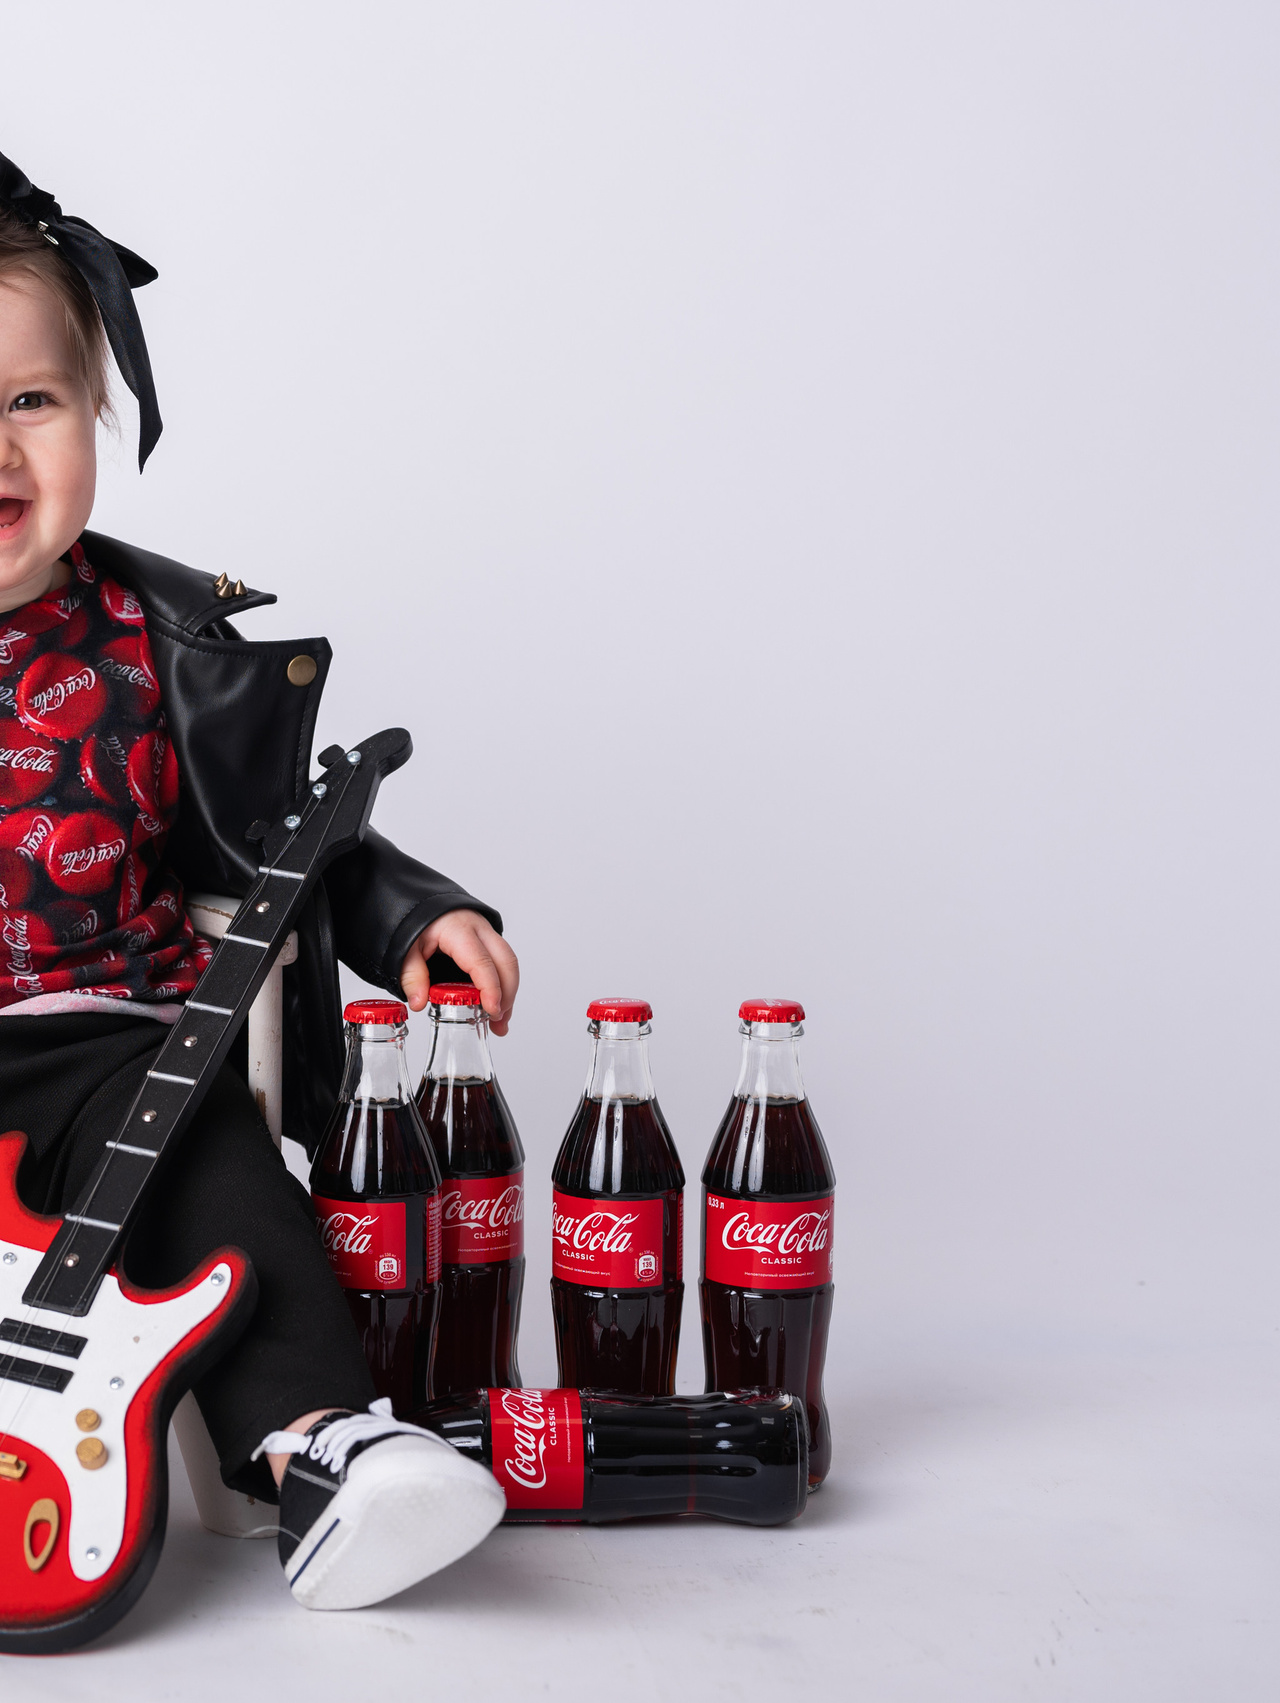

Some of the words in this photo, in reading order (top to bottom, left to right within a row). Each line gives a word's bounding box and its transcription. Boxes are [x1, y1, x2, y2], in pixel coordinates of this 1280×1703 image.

[23, 667, 96, 719] Coca-Cola
[58, 838, 125, 877] Coca-Cola
[3, 914, 33, 976] Coca-Cola
[473, 1229, 509, 1240] CLASSIC
[722, 1209, 831, 1254] Coca-Cola
[562, 1249, 595, 1261] CLASSIC
[761, 1257, 802, 1265] CLASSIC
[500, 1388, 546, 1489] Coca-Cola
[547, 1407, 557, 1446] CLASSIC
